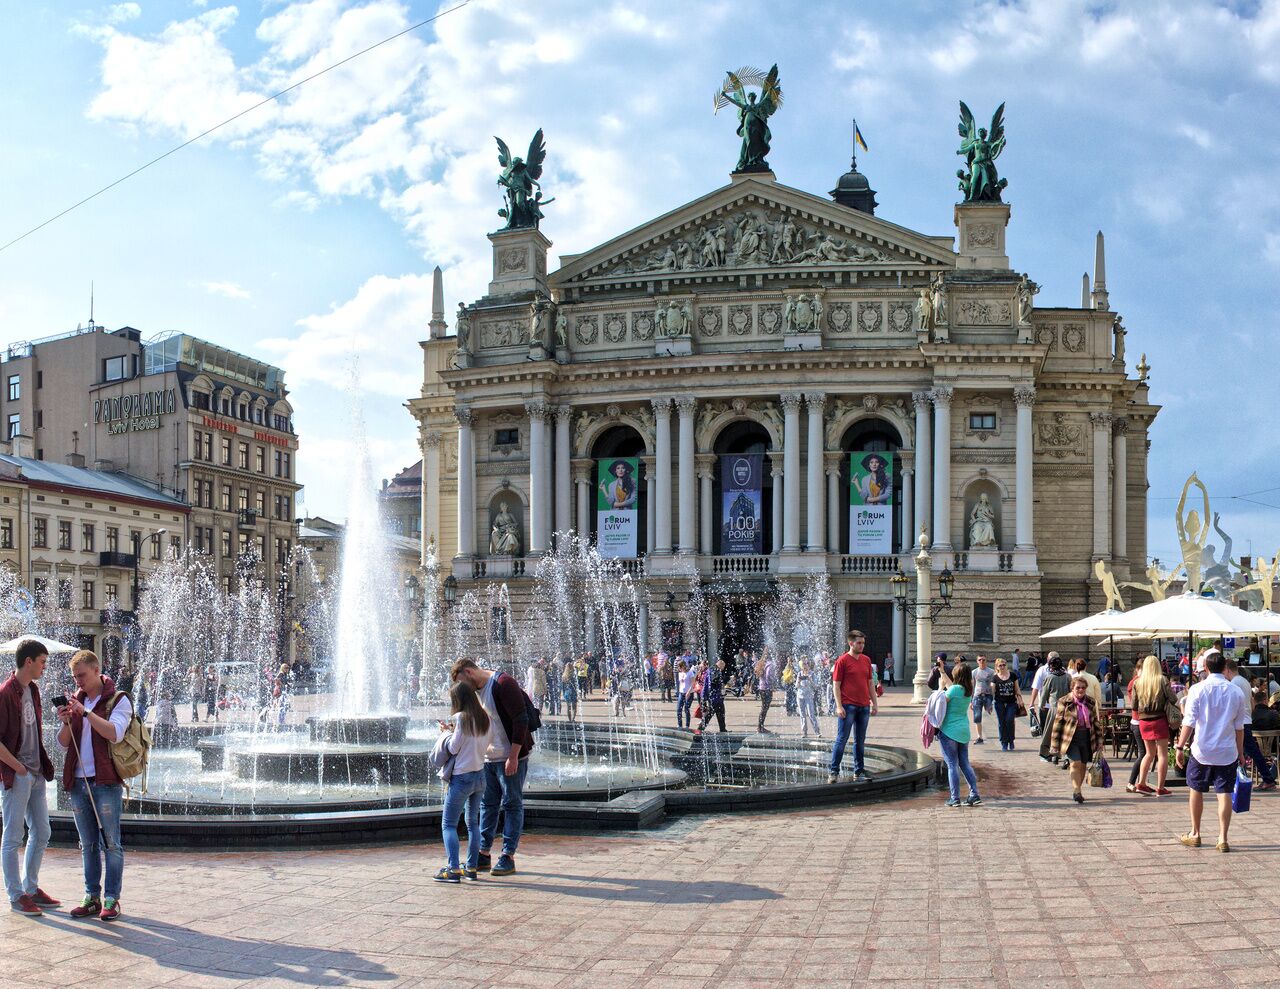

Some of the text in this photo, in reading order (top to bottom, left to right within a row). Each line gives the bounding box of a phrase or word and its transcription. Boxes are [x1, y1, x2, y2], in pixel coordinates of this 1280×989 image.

[93, 388, 176, 423] PANORAMA
[107, 416, 160, 435] Lviv Hotel
[604, 515, 631, 524] FORUM
[857, 511, 885, 519] FORUM
[728, 516, 755, 531] 100
[728, 530, 755, 539] РОКІВ
